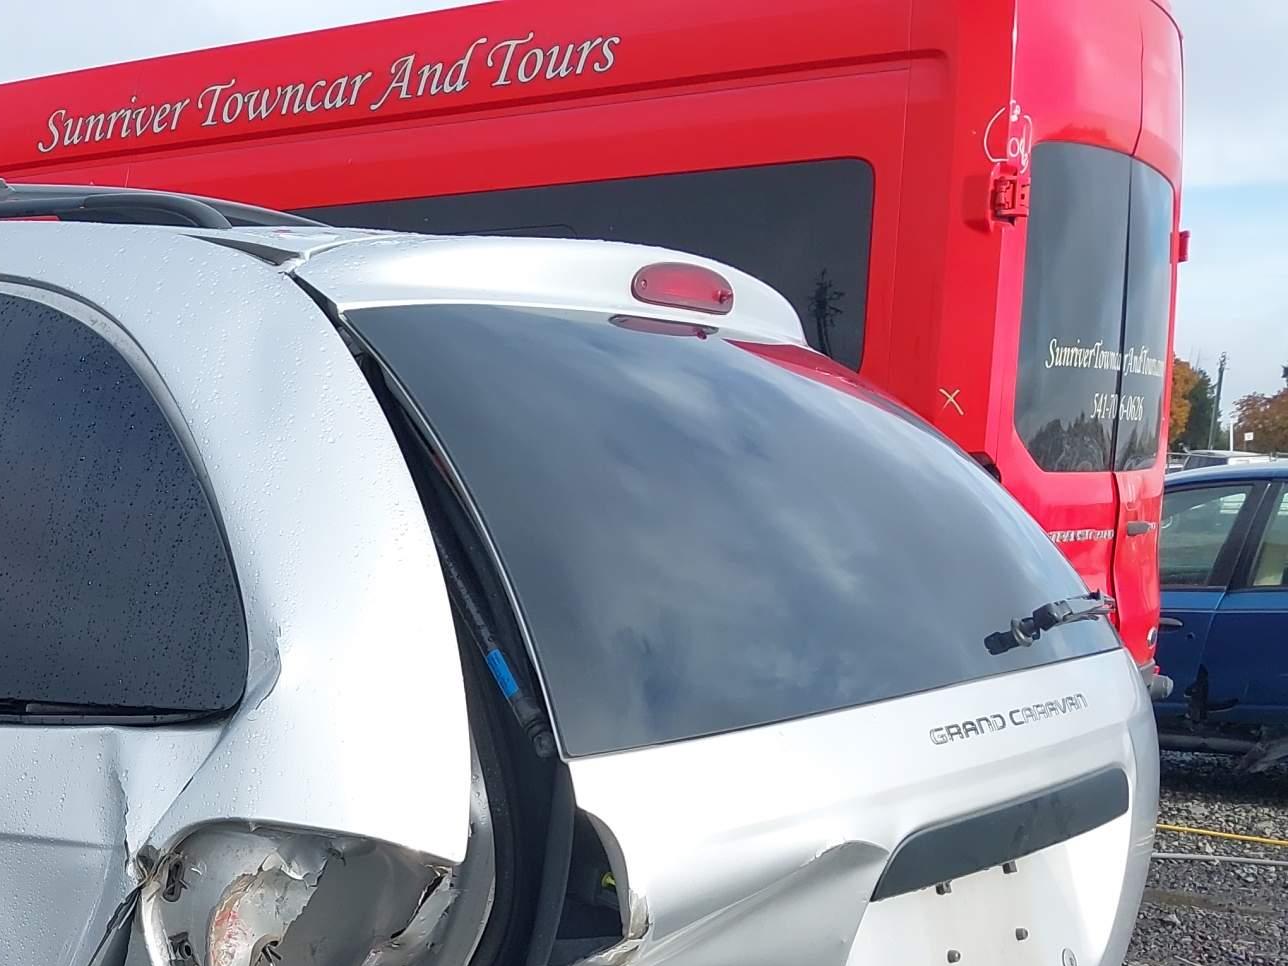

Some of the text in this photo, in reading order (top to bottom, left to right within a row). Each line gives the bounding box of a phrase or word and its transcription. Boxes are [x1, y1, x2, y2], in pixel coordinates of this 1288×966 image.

[37, 32, 621, 153] Sunriver Towncar And Tours
[929, 693, 1088, 745] GRAND CARAVAN
